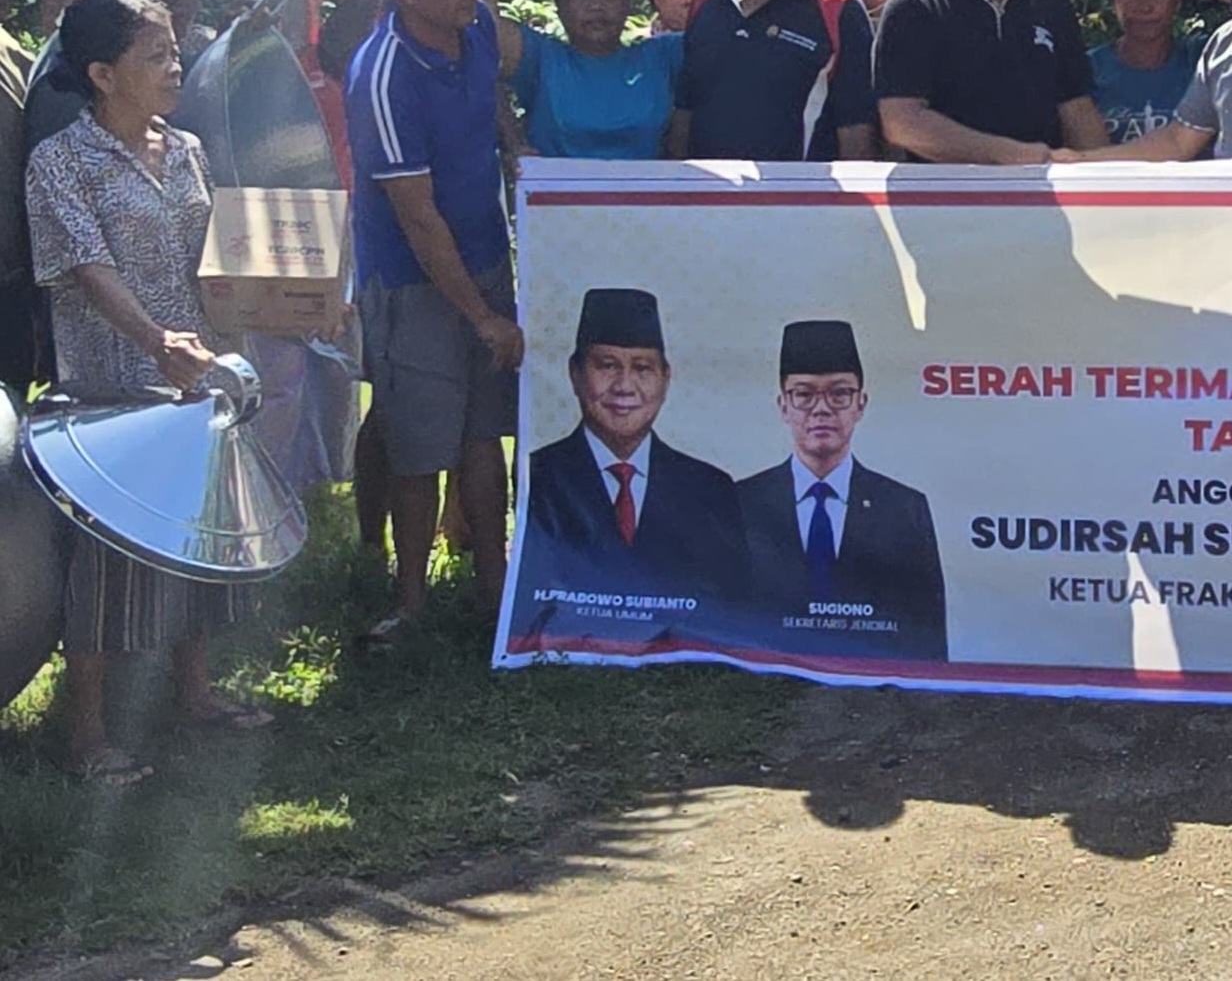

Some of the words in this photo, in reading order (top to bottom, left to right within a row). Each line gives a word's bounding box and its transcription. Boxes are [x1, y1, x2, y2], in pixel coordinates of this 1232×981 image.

[922, 364, 1073, 398] SERAH
[970, 516, 1194, 556] SUDIRSAH
[1049, 577, 1151, 605] KETUA
[576, 606, 613, 618] KETUA
[625, 595, 697, 611] SUBIANTO
[808, 602, 874, 616] SUGIONO
